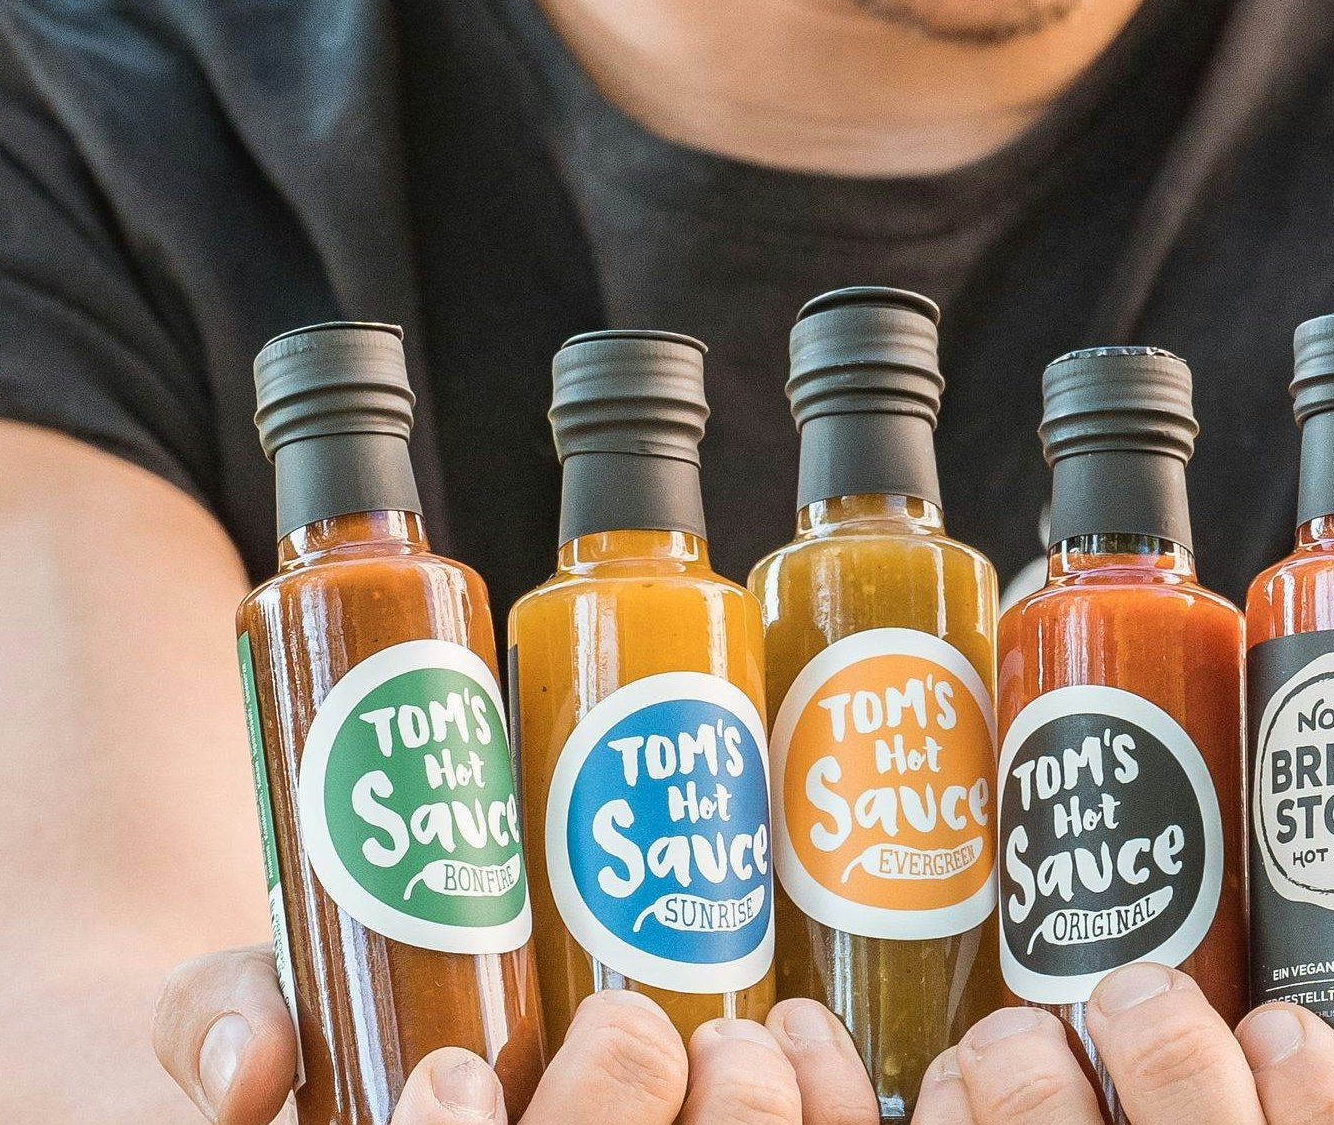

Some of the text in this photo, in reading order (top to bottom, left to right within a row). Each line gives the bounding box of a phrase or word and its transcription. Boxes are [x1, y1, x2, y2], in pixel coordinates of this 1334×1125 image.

[360, 688, 492, 757] TOM'S
[818, 674, 957, 742] TOM'S
[424, 749, 485, 791] Hot
[607, 719, 745, 786] TOM'S
[875, 734, 943, 775] Hot
[1012, 728, 1140, 811] TOM'S
[351, 769, 520, 868] Sauce
[668, 781, 733, 824] Hot
[805, 755, 990, 852] Sauce
[1053, 793, 1121, 838] Hot
[592, 798, 769, 899] Sauce
[878, 844, 977, 876] EVERGREEN
[1292, 848, 1329, 868] HOT
[443, 862, 515, 894] BONFIRE
[1006, 824, 1185, 923] Sauce
[664, 897, 755, 927] SUNRISE
[1053, 897, 1156, 942] ORIGINAL
[1273, 967, 1289, 981] EIN
